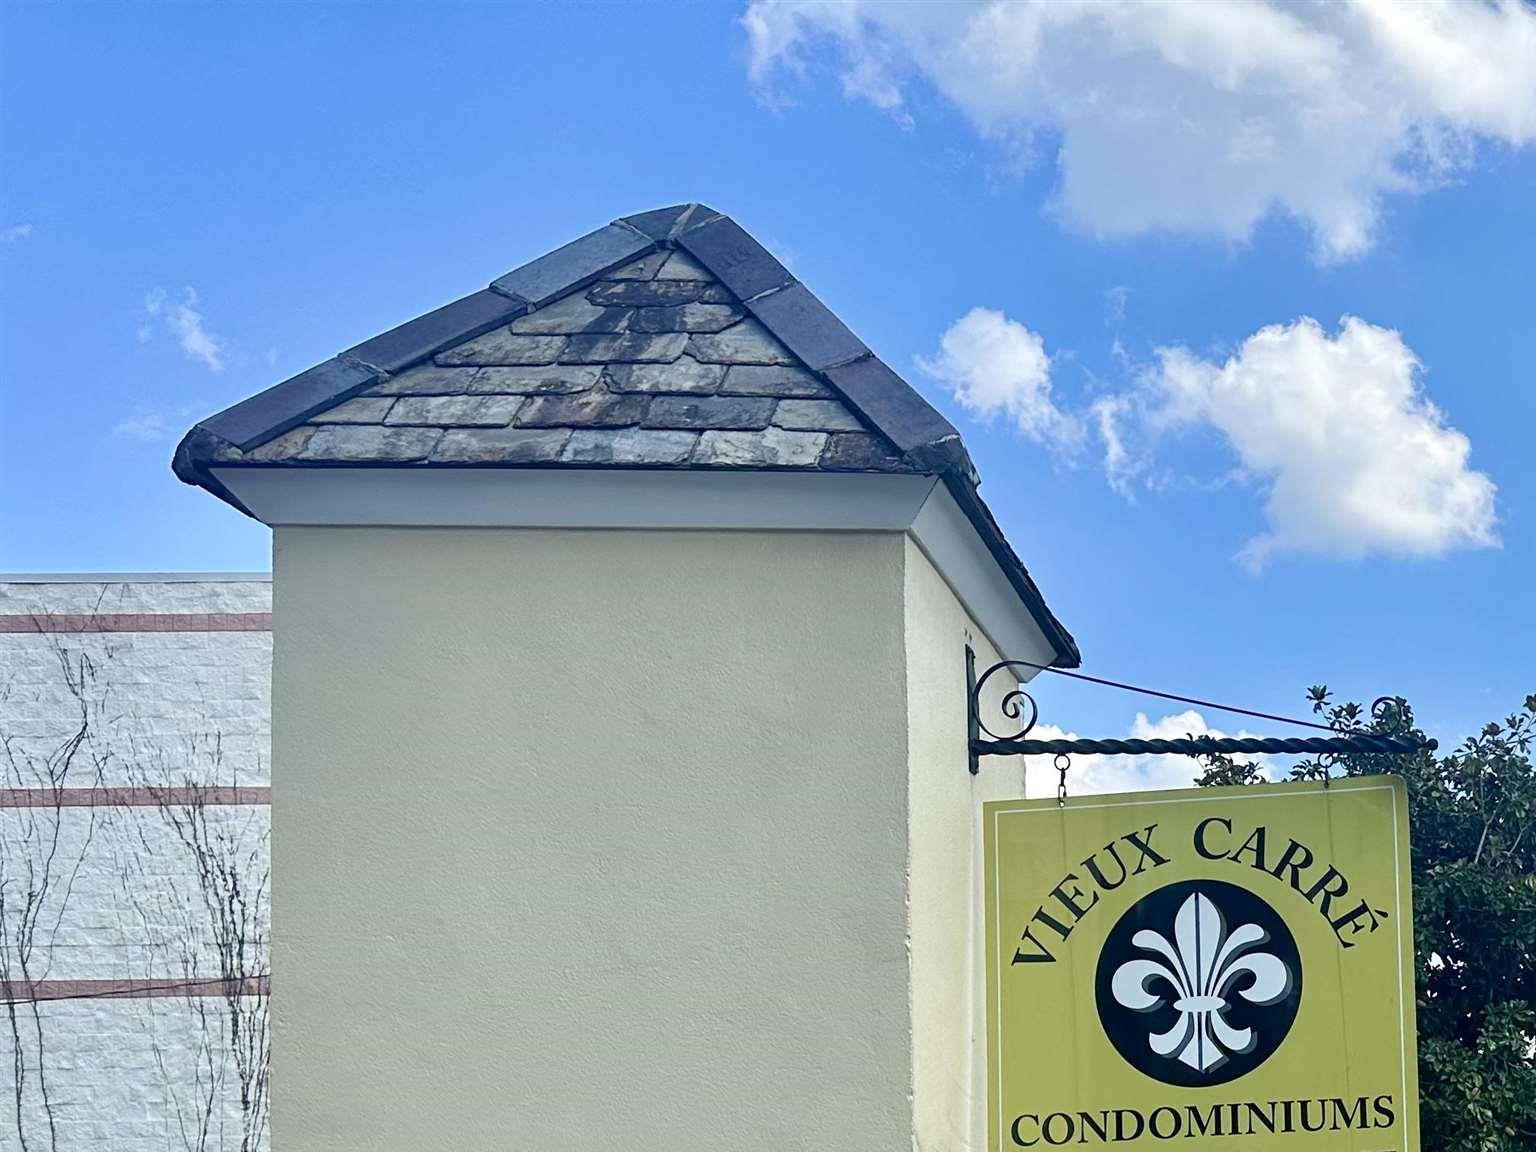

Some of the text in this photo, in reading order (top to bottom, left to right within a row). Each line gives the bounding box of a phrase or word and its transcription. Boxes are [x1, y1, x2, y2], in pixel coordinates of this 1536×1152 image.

[1011, 817, 1389, 966] VIEUX CARRÉ
[1011, 1095, 1395, 1147] CONDOMINIUMS
